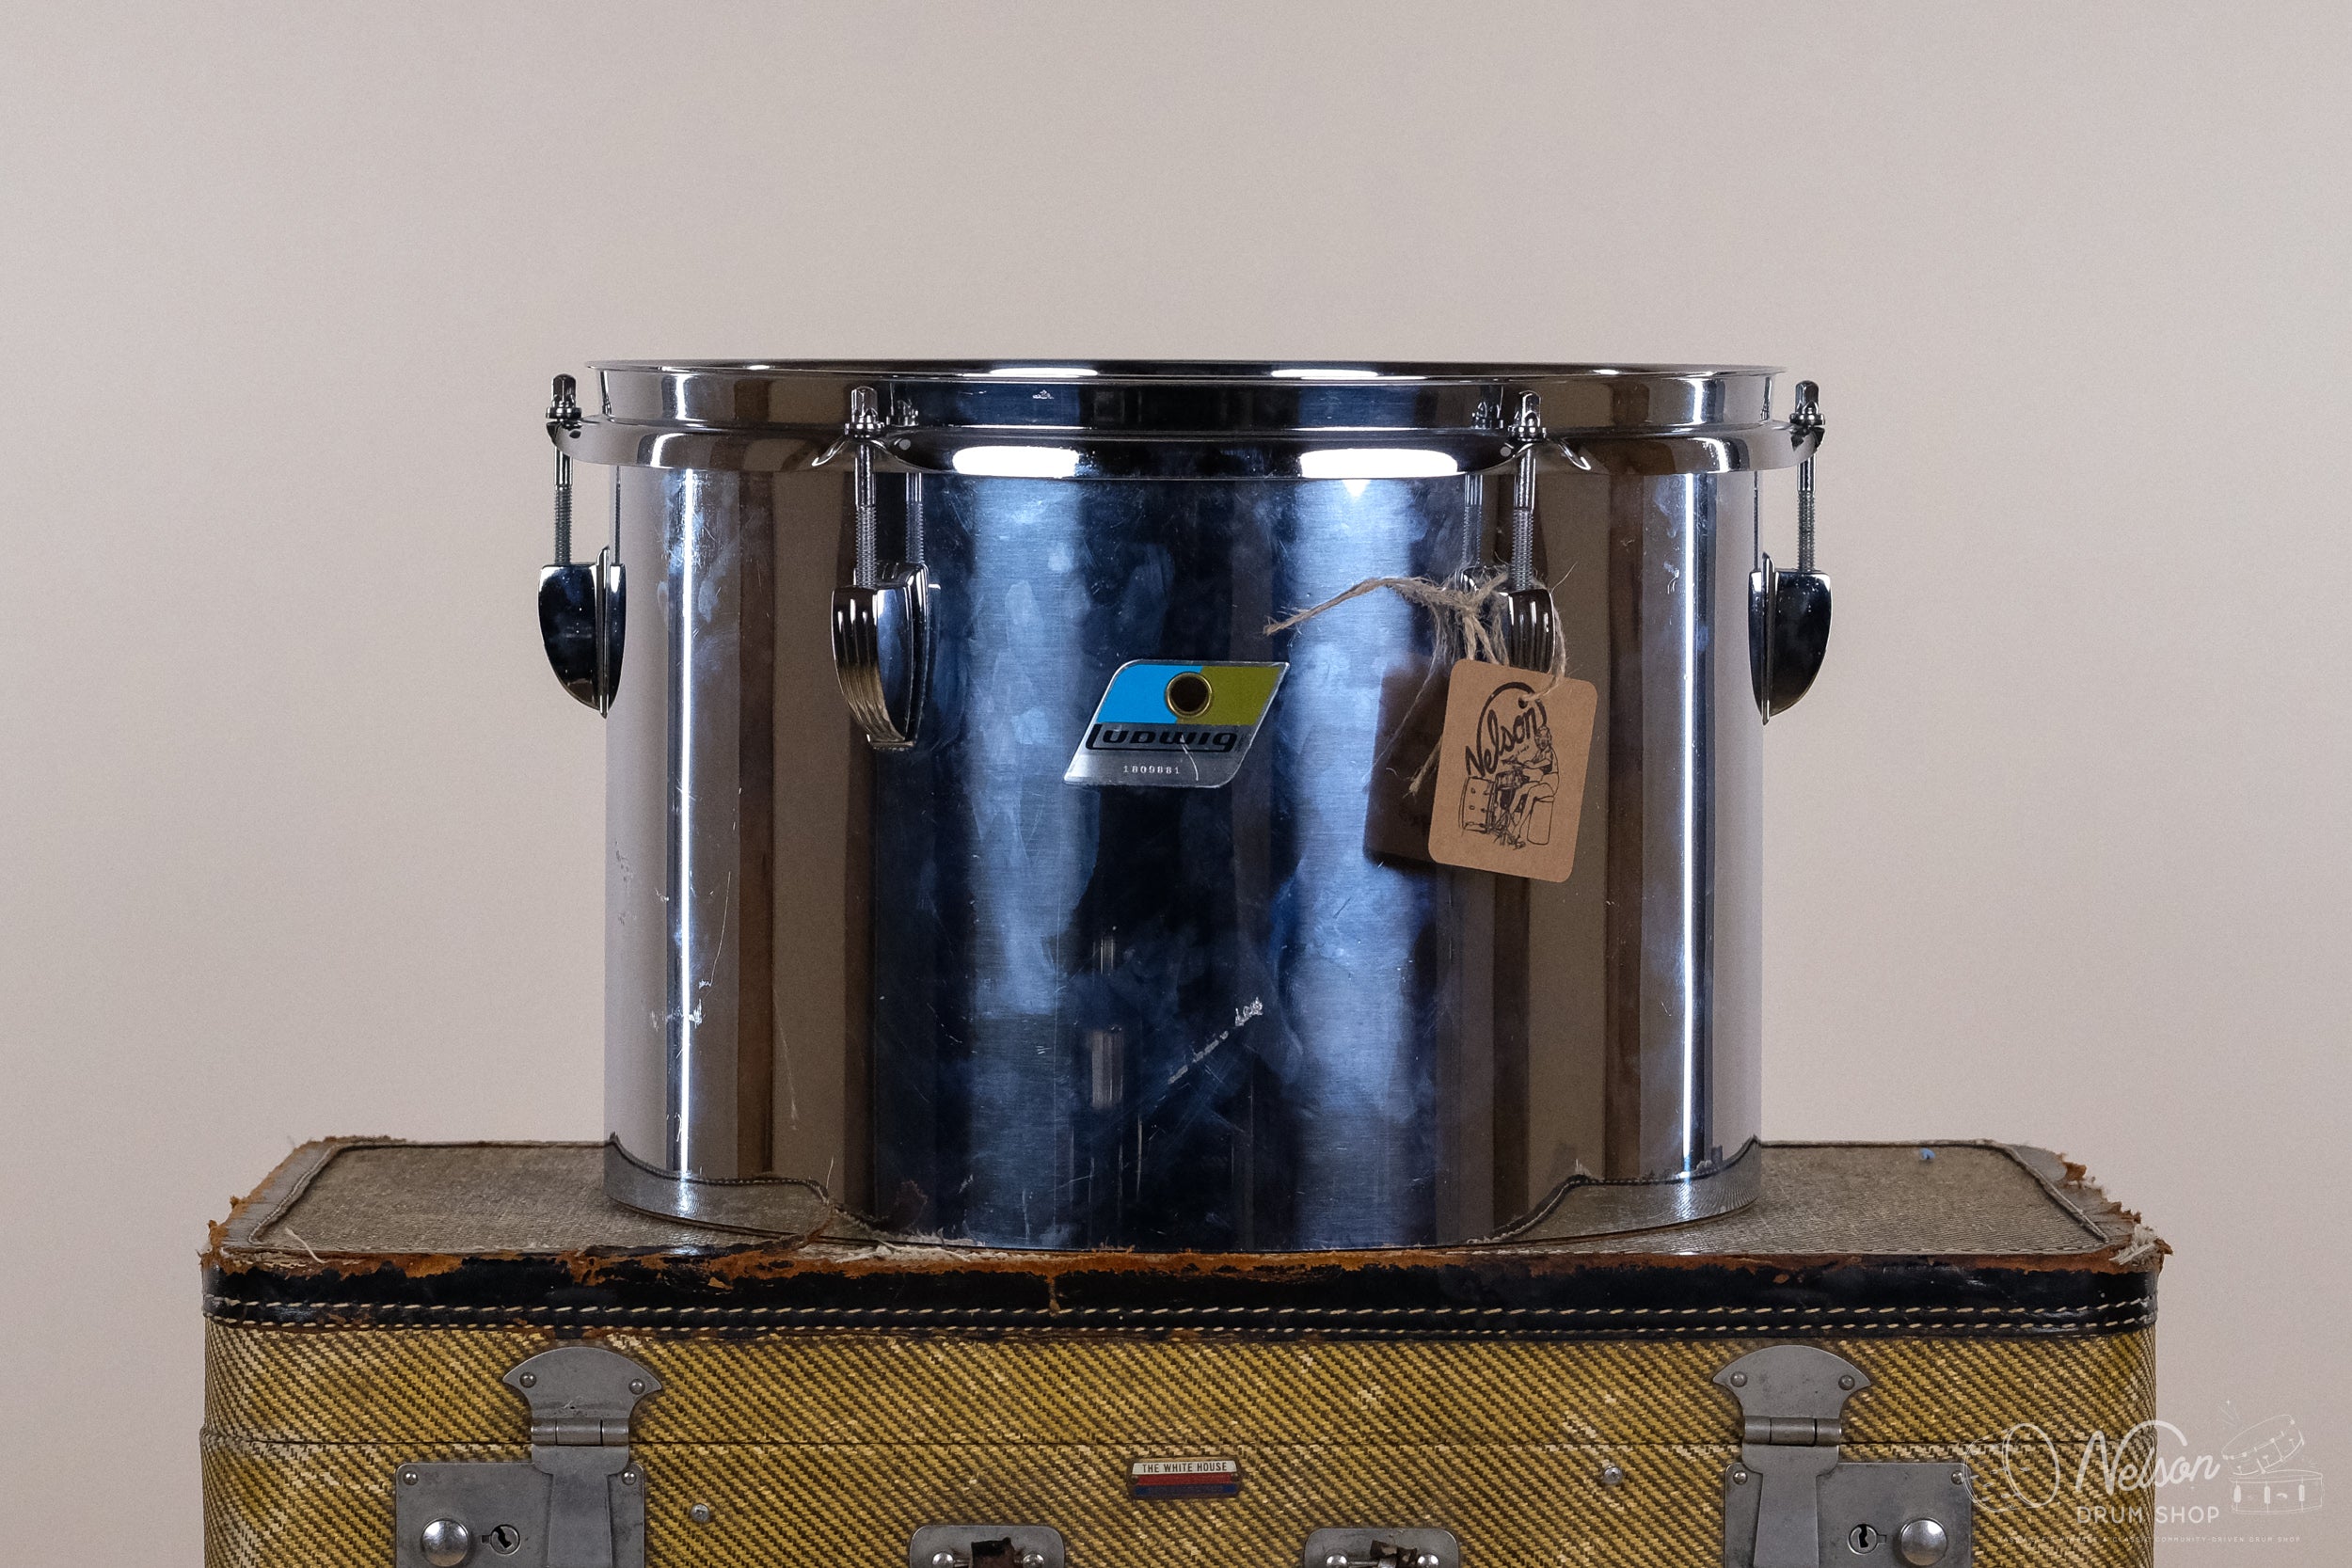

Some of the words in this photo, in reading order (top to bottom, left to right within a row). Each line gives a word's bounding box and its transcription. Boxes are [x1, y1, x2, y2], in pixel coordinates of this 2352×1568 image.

[1464, 680, 1549, 779] Nelson
[1142, 1464, 1160, 1474] THE
[1163, 1463, 1193, 1473] WHITE
[1197, 1462, 1228, 1472] HOUSE
